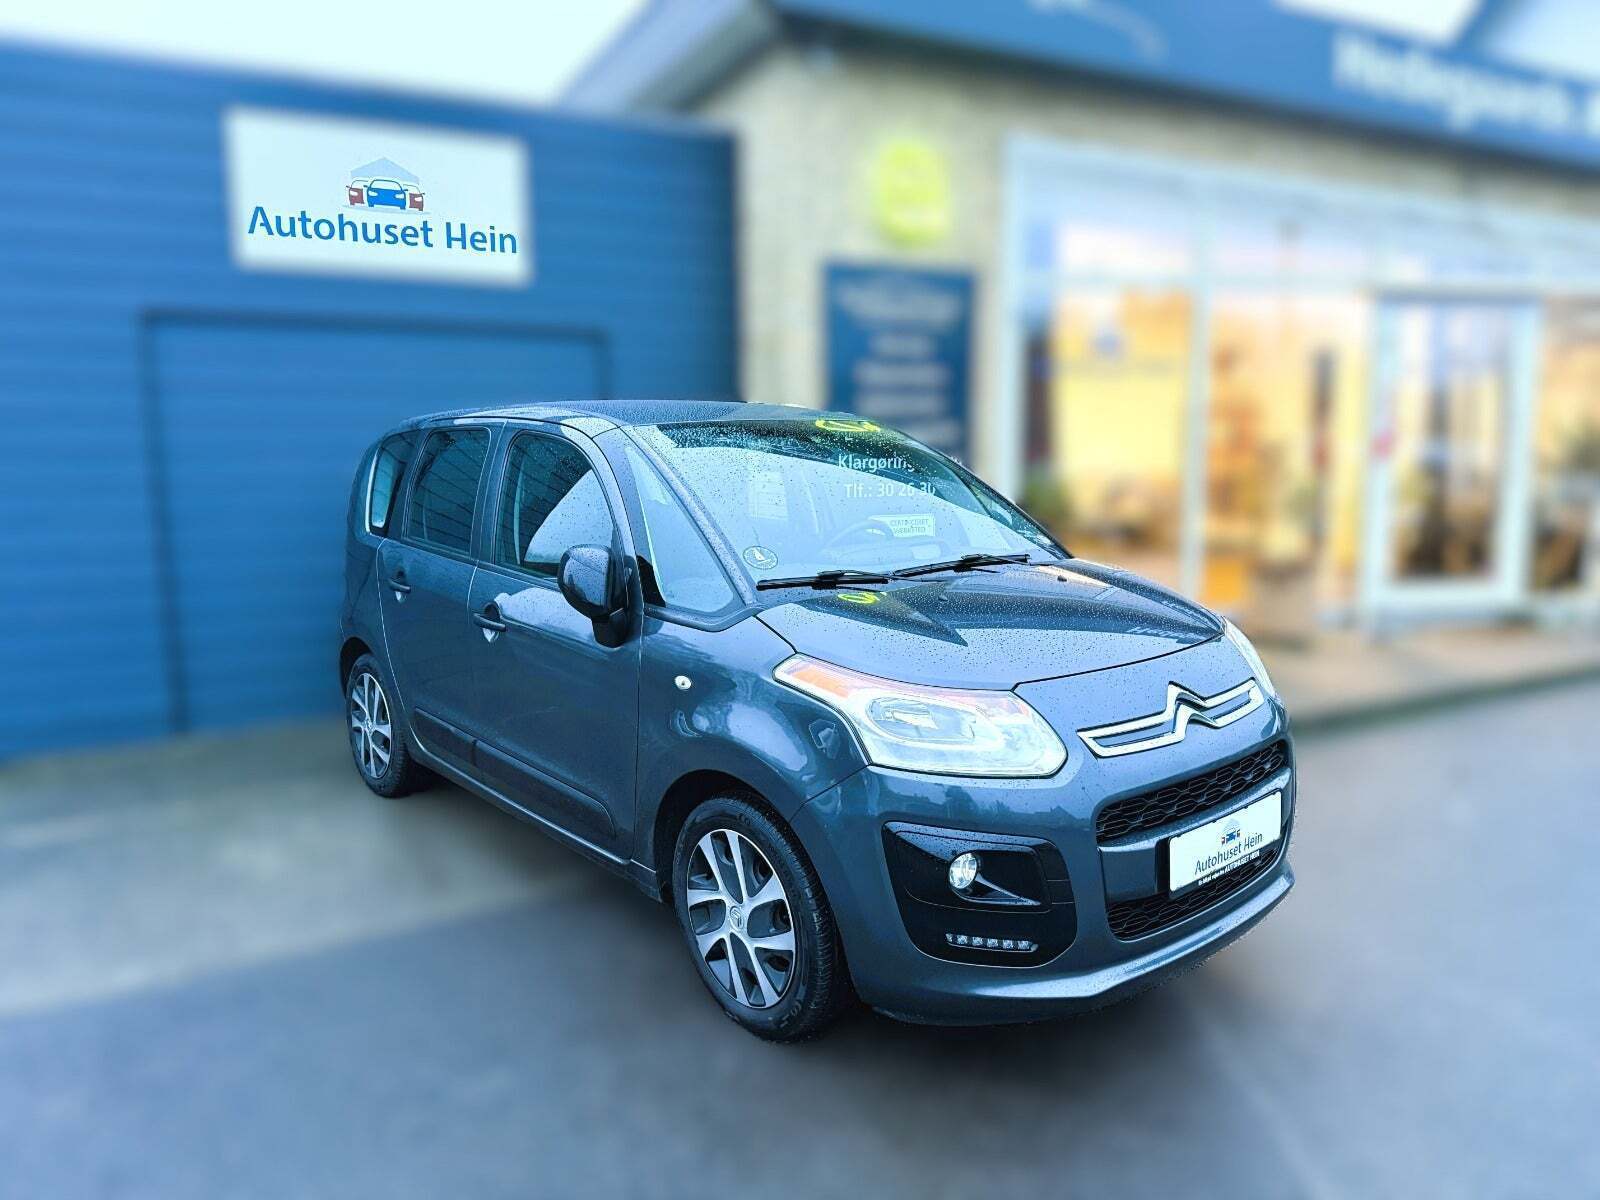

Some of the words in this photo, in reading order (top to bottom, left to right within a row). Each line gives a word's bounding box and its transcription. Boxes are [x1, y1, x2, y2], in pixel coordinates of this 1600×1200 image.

[248, 206, 433, 248] Autohuset
[446, 222, 518, 253] Hein
[876, 484, 894, 497] 30
[1195, 842, 1241, 875] Autohuset
[1244, 833, 1263, 851] Hein
